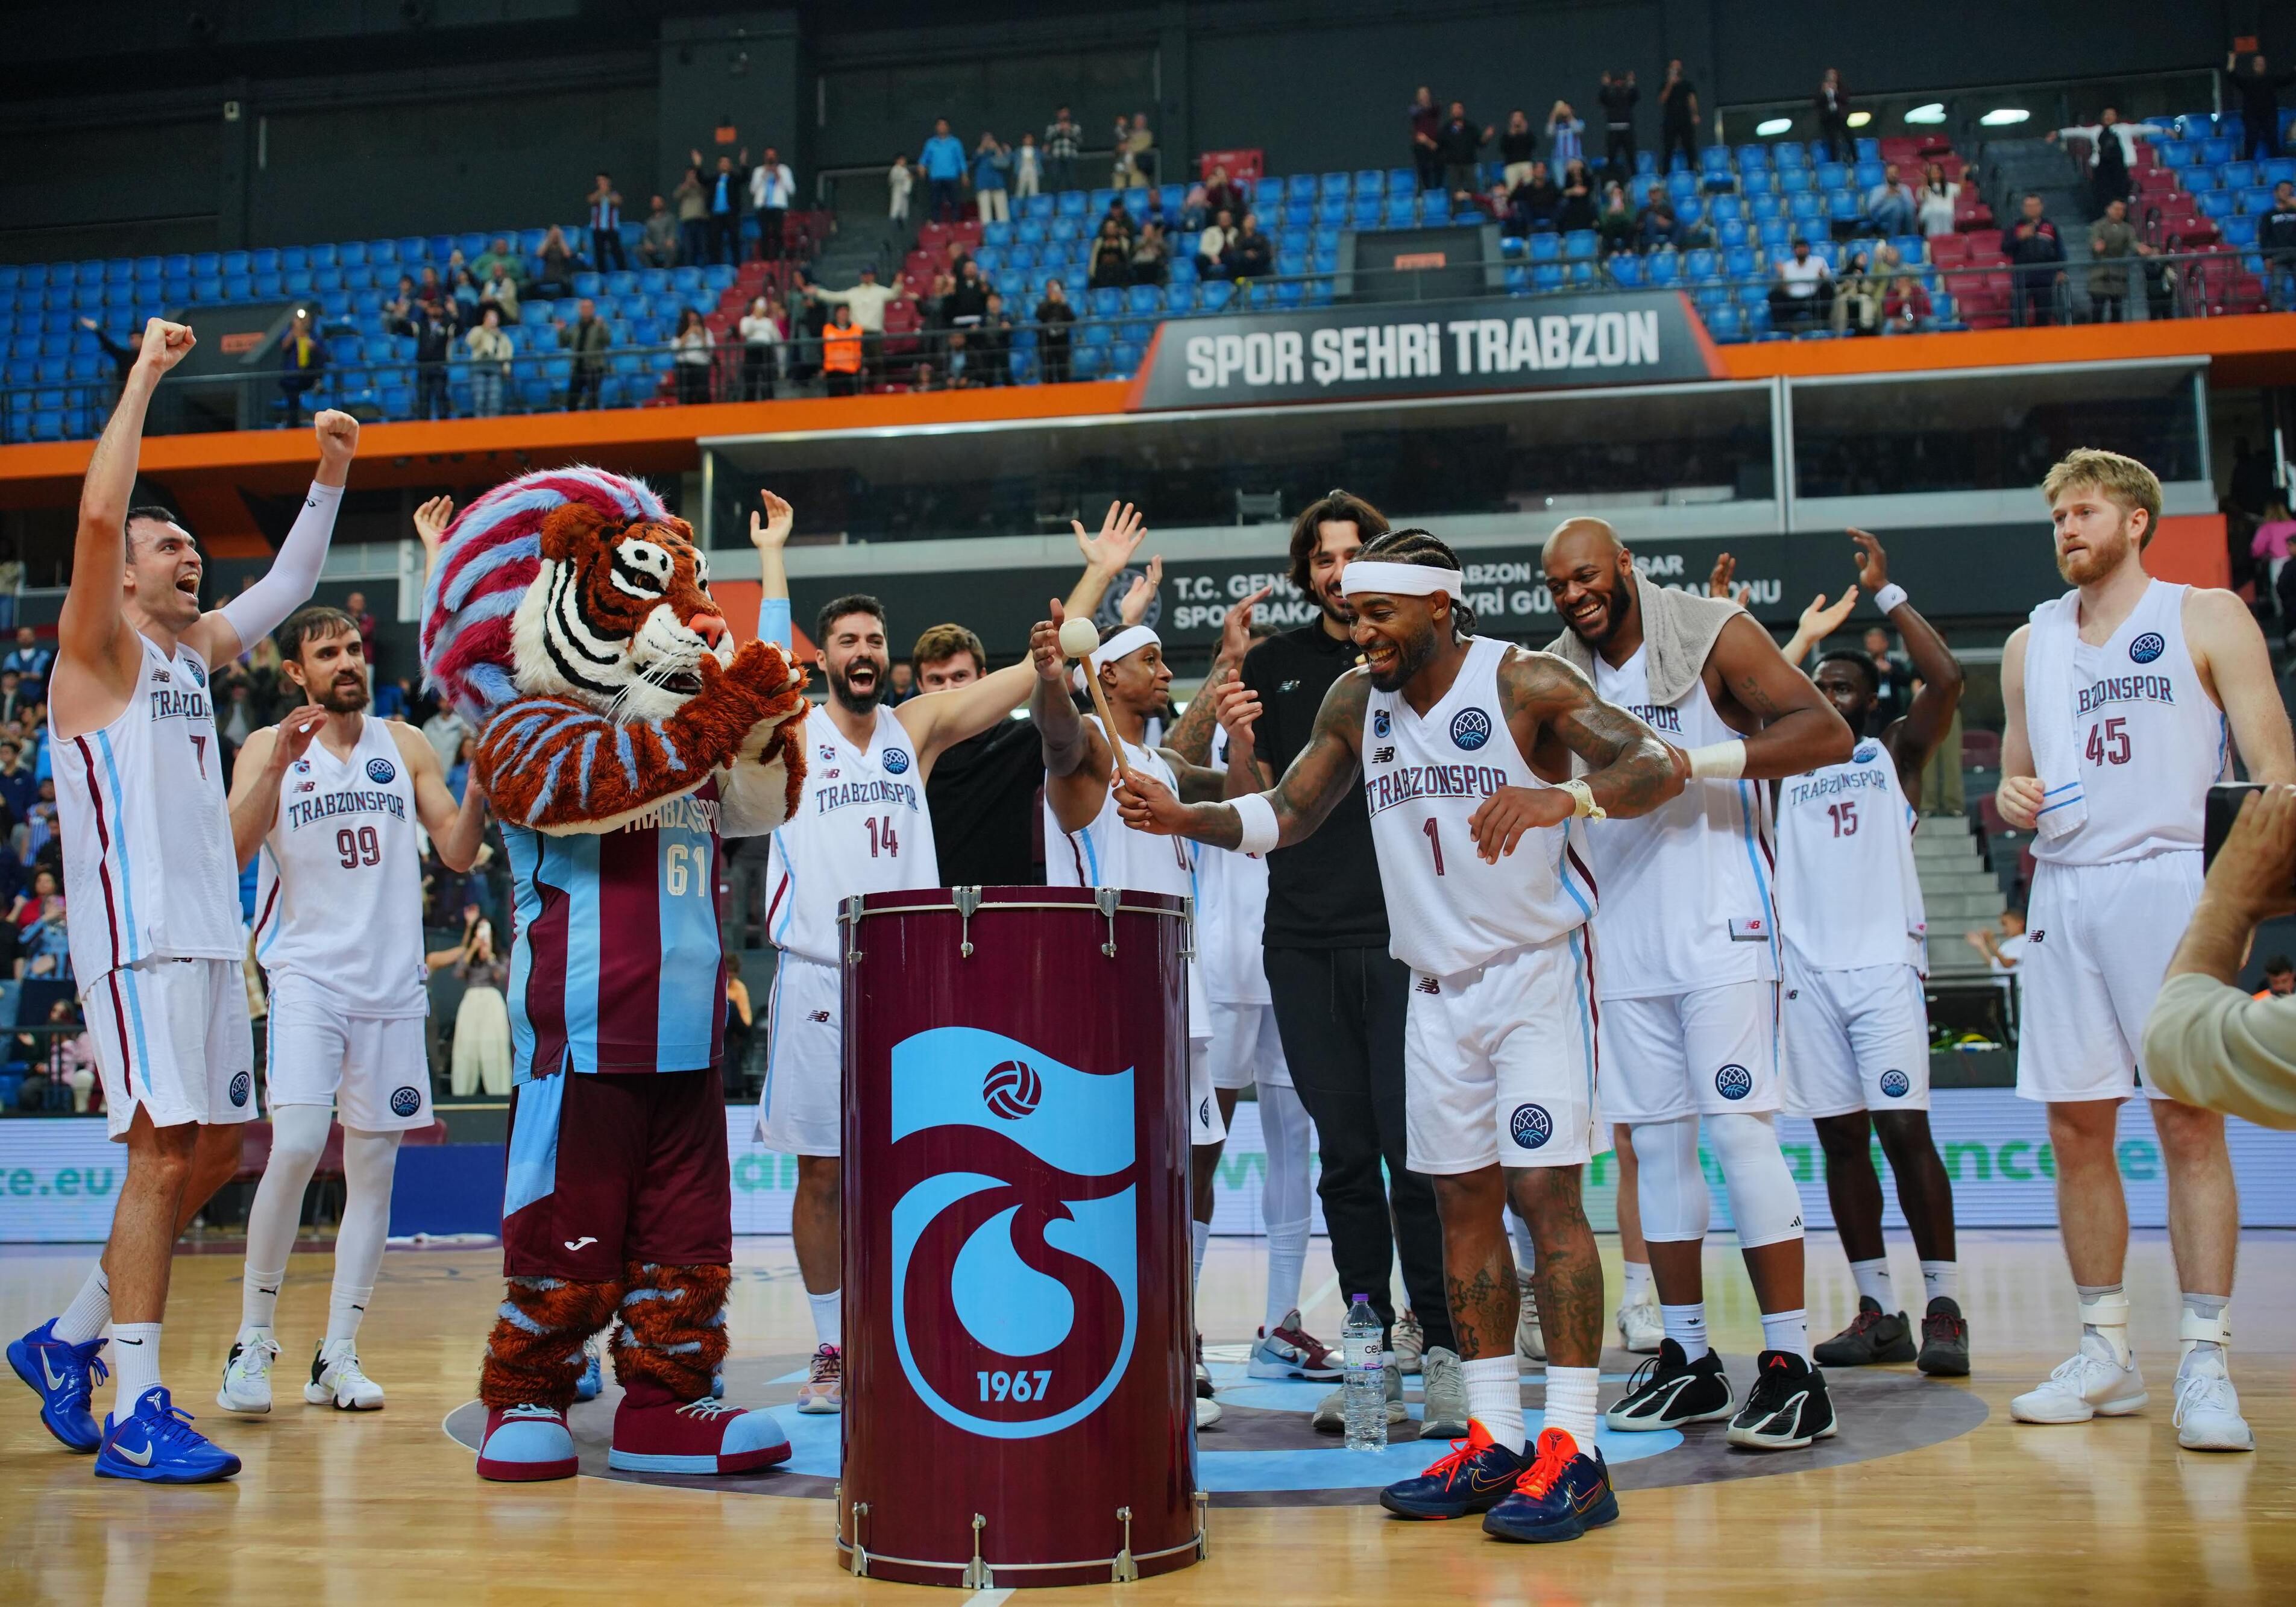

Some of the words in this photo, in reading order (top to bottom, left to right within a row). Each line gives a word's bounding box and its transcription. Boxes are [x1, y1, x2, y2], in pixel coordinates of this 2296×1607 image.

[1186, 331, 1304, 388] SPOR
[1448, 310, 1661, 374] TRABZON
[1172, 576, 1222, 600] T.C.
[1461, 562, 1532, 585] ABZON
[1174, 605, 1238, 629] SPO
[1510, 584, 1558, 615] GÜ
[189, 734, 207, 781] 7
[2086, 717, 2131, 767] 45
[289, 791, 406, 829] TRABZONSPOR
[816, 779, 918, 813] TRABZONSPOR
[864, 816, 898, 858] 14
[1828, 802, 1857, 838] 15
[337, 826, 380, 869] 99
[1423, 817, 1445, 876] 1
[667, 844, 706, 897] 61
[0, 1167, 113, 1196] e.eu
[977, 1370, 1052, 1403] 1967
